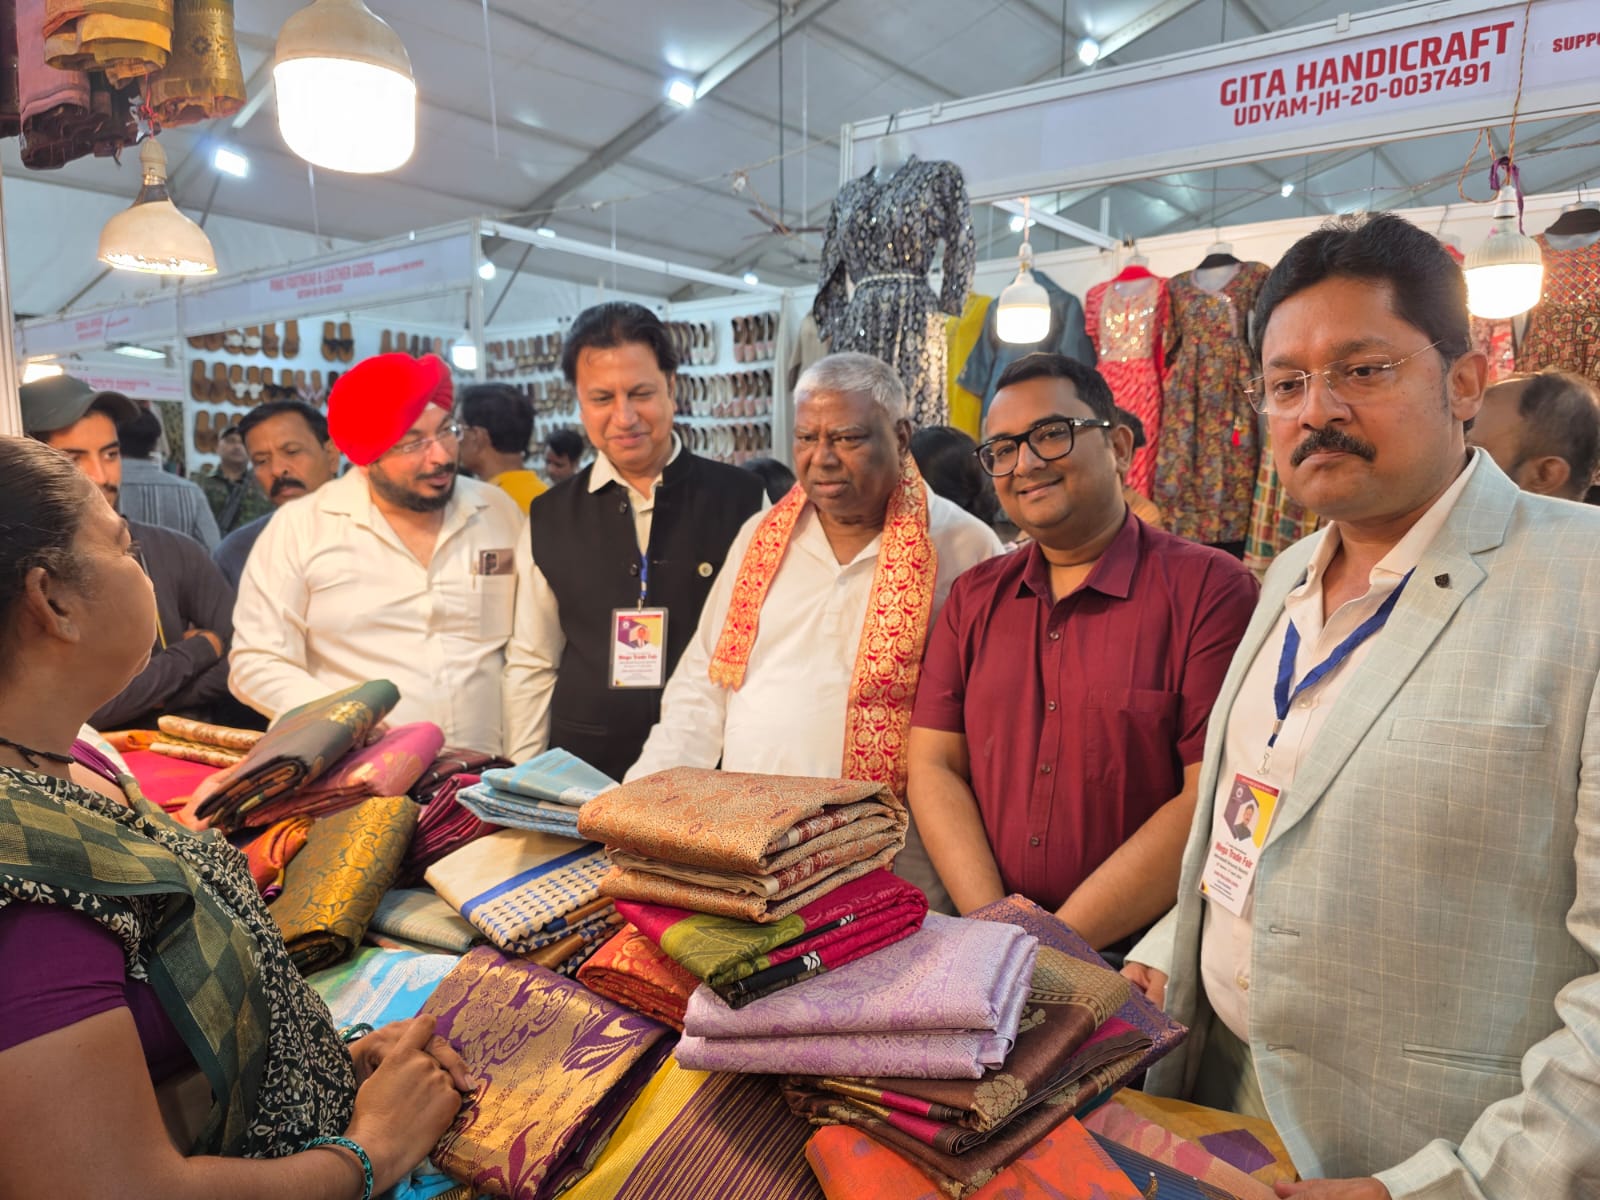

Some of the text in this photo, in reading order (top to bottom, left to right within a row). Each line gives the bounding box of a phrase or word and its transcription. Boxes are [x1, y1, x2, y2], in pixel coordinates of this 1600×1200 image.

[1220, 21, 1515, 106] GITA HANDICRAFT
[1234, 61, 1491, 126] UDYAM-JH-20-0037491
[1228, 849, 1242, 862] Trade
